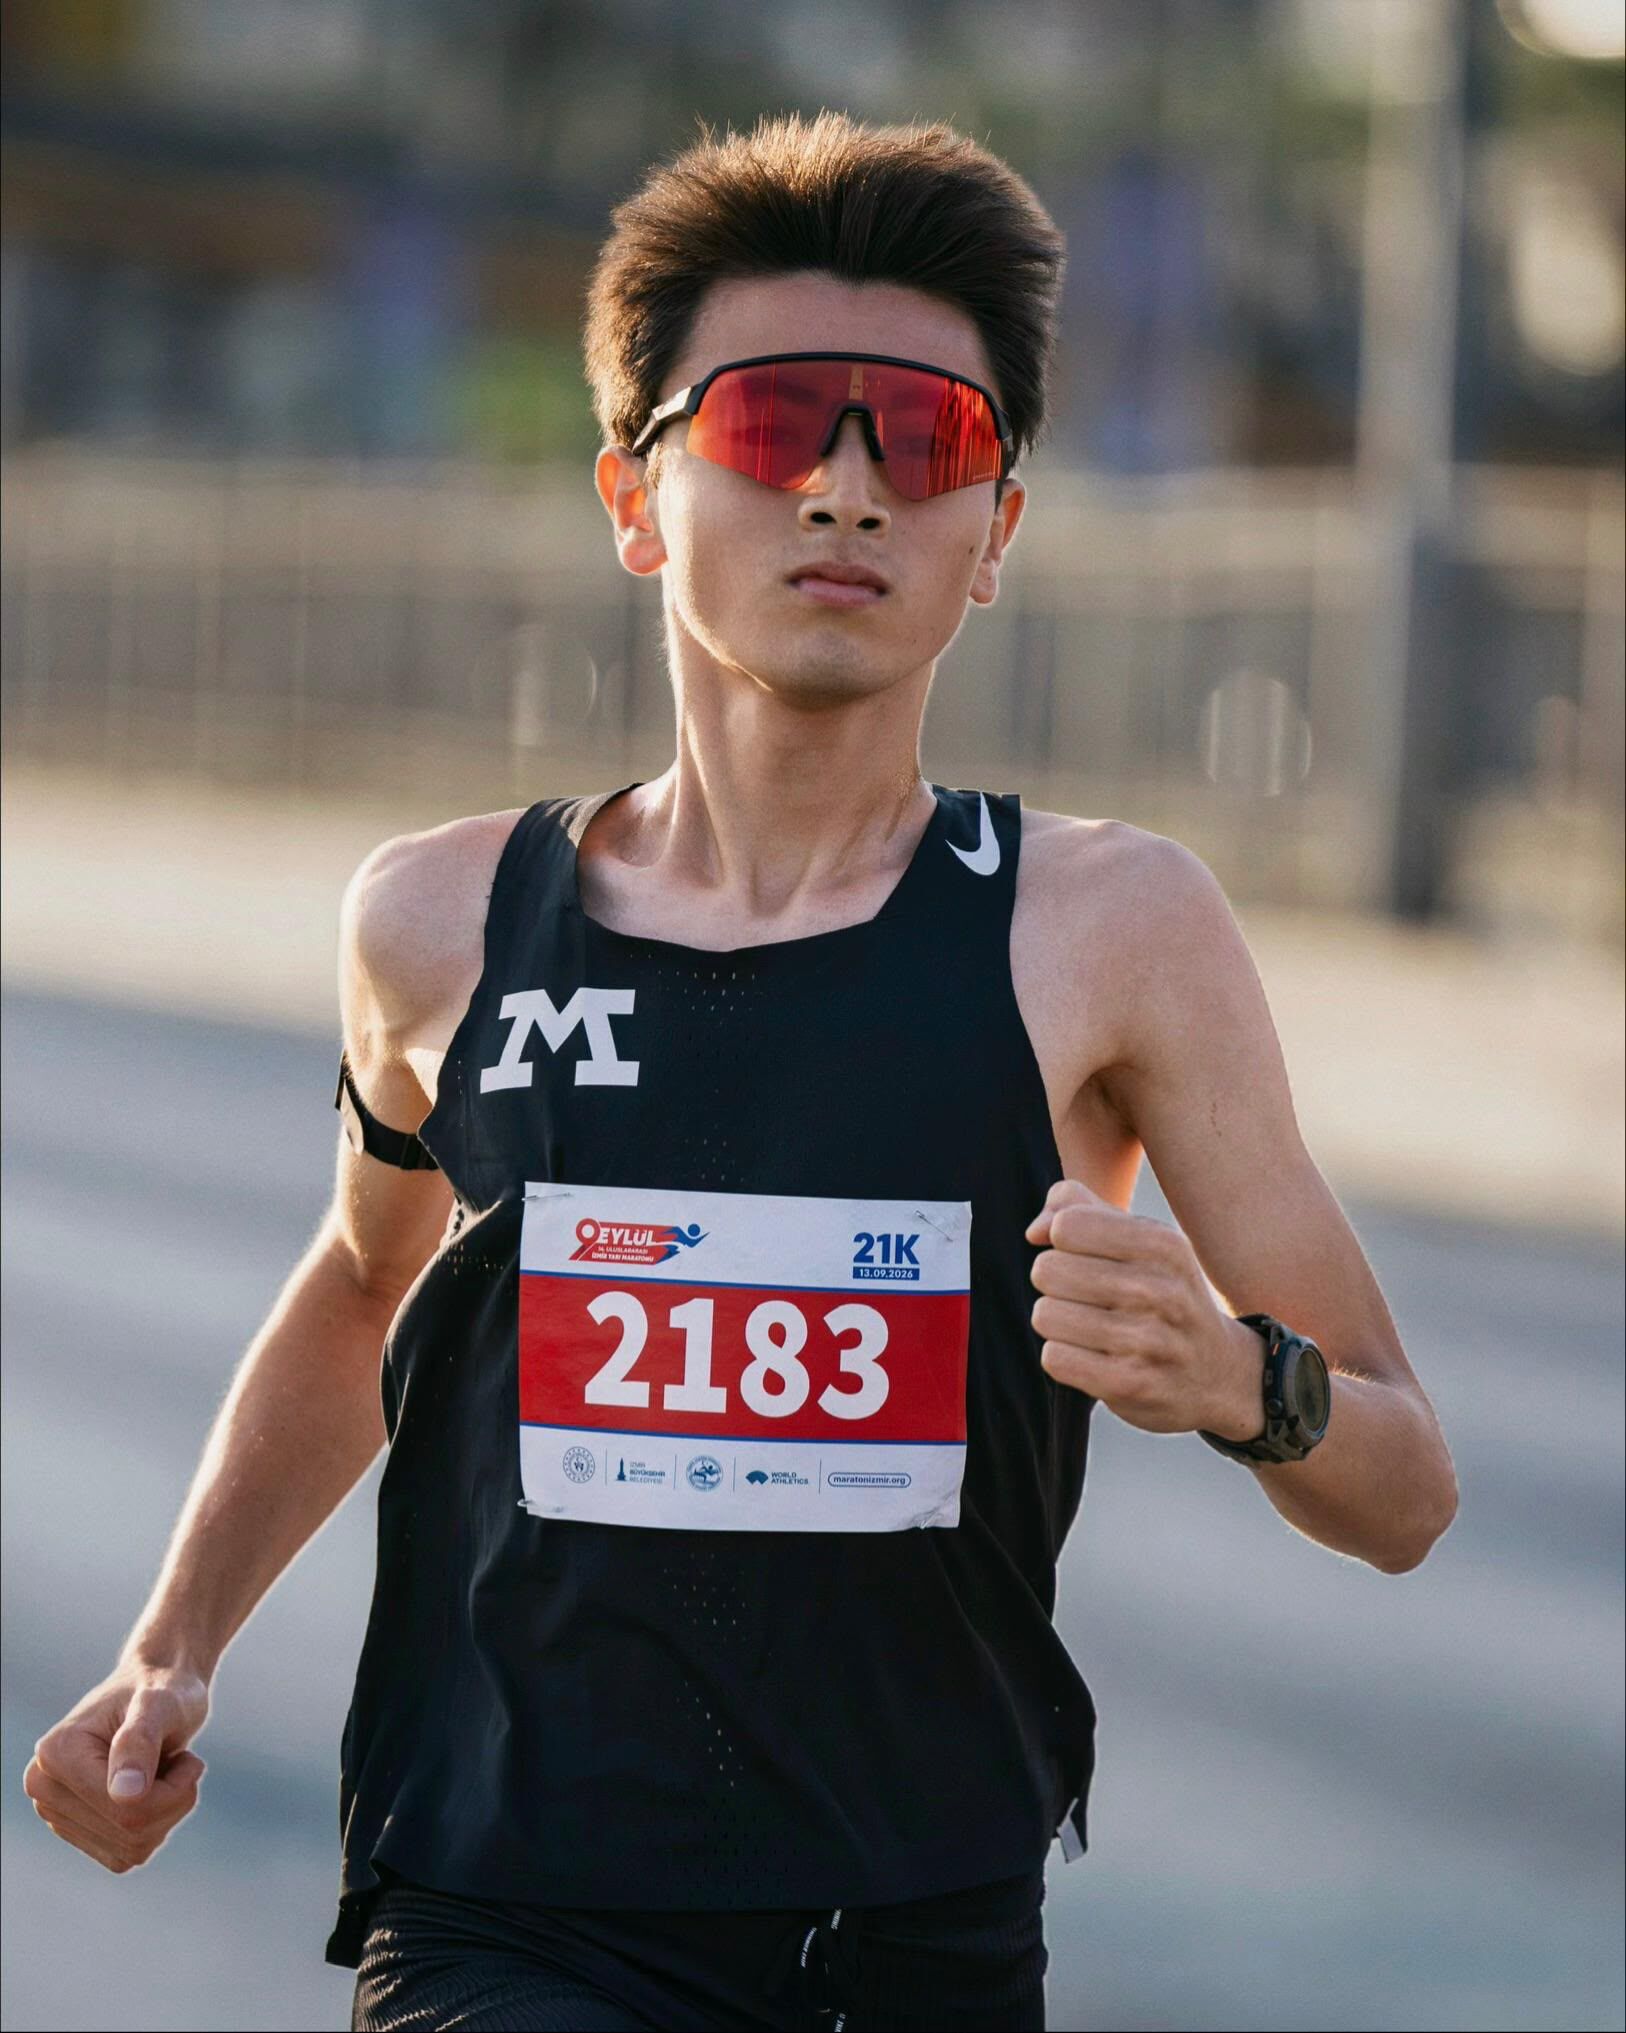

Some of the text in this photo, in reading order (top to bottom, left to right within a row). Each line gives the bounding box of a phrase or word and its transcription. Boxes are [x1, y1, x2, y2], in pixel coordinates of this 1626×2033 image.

[480, 987, 640, 1094] M
[599, 1227, 655, 1246] EYLÜL
[853, 1232, 920, 1265] 21K
[859, 1268, 914, 1279] 13.09.2026
[585, 1291, 889, 1420] 2183
[833, 1476, 906, 1486] maratonizmir.org
